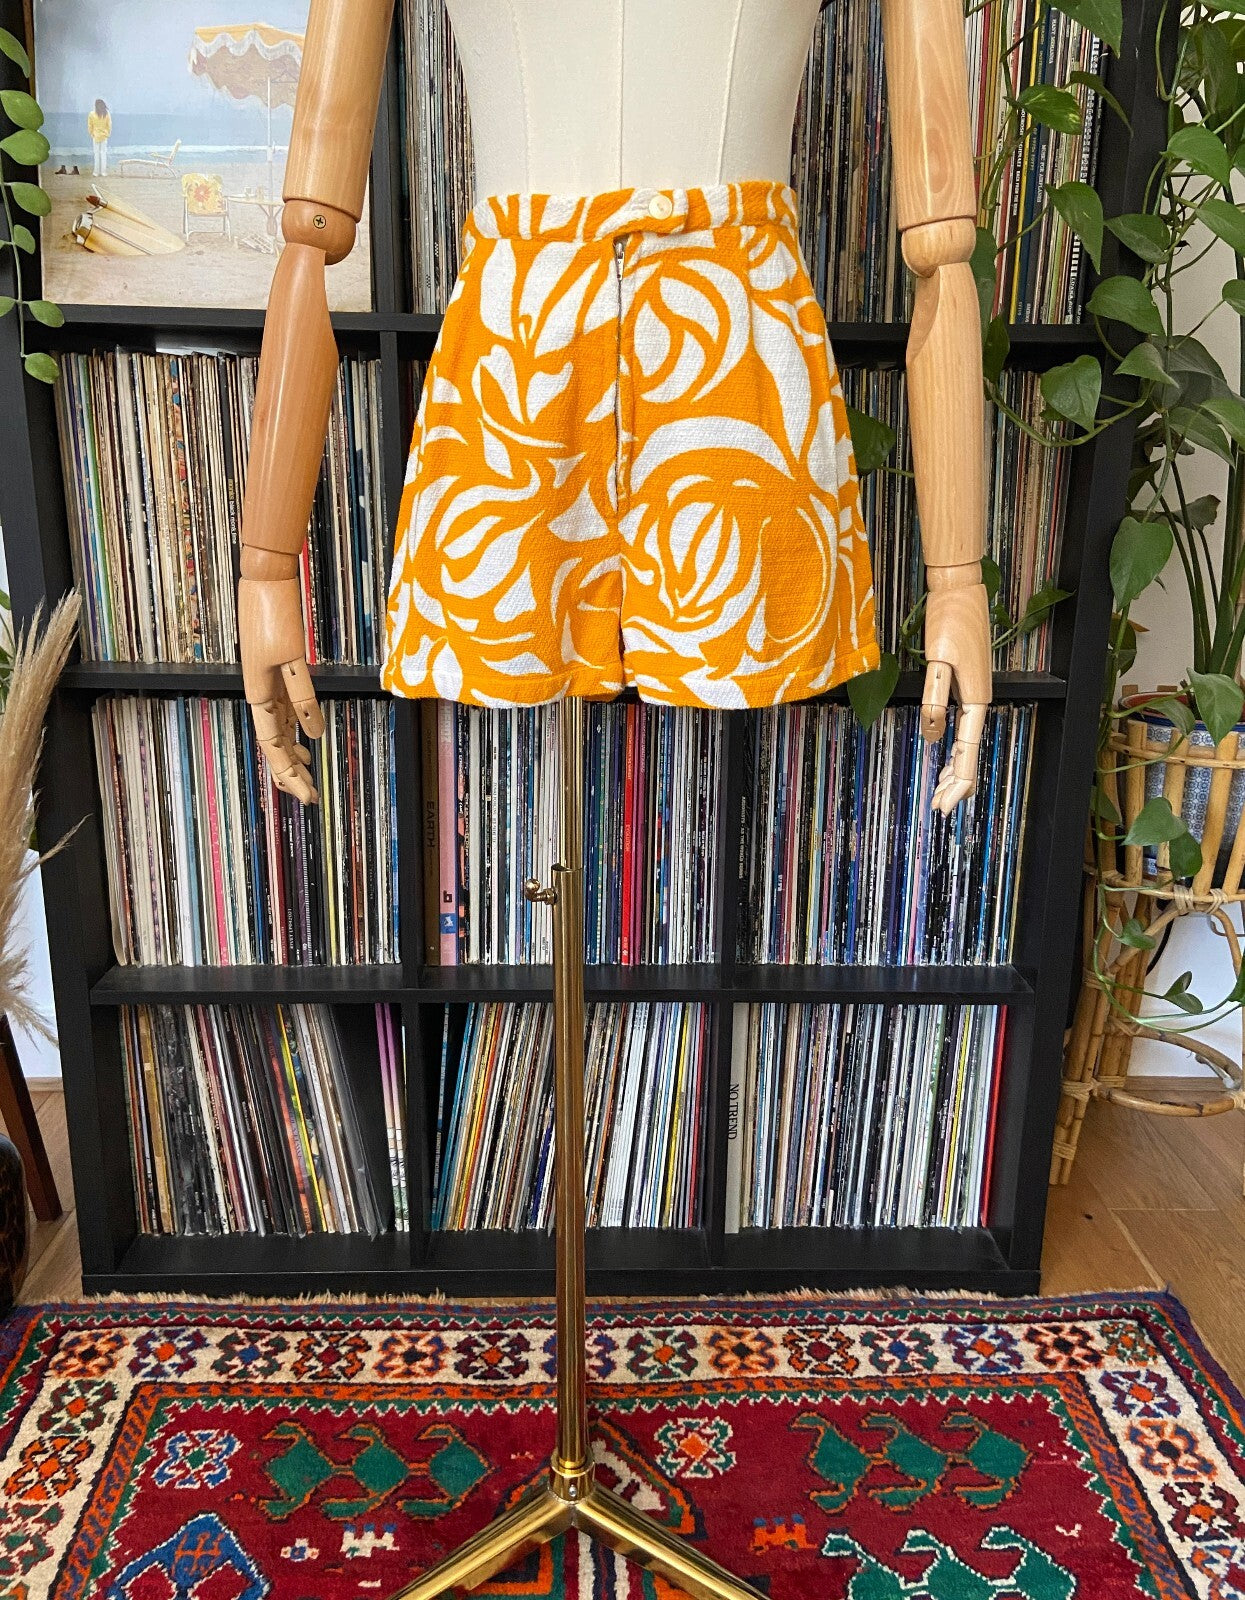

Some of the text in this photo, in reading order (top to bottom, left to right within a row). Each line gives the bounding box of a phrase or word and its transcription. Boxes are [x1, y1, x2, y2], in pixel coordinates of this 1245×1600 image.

[1037, 173, 1045, 203] AIRPLANES
[228, 479, 236, 500] monks
[229, 500, 237, 516] black
[427, 800, 436, 848] EARTH
[727, 1083, 740, 1140] NO TREND
